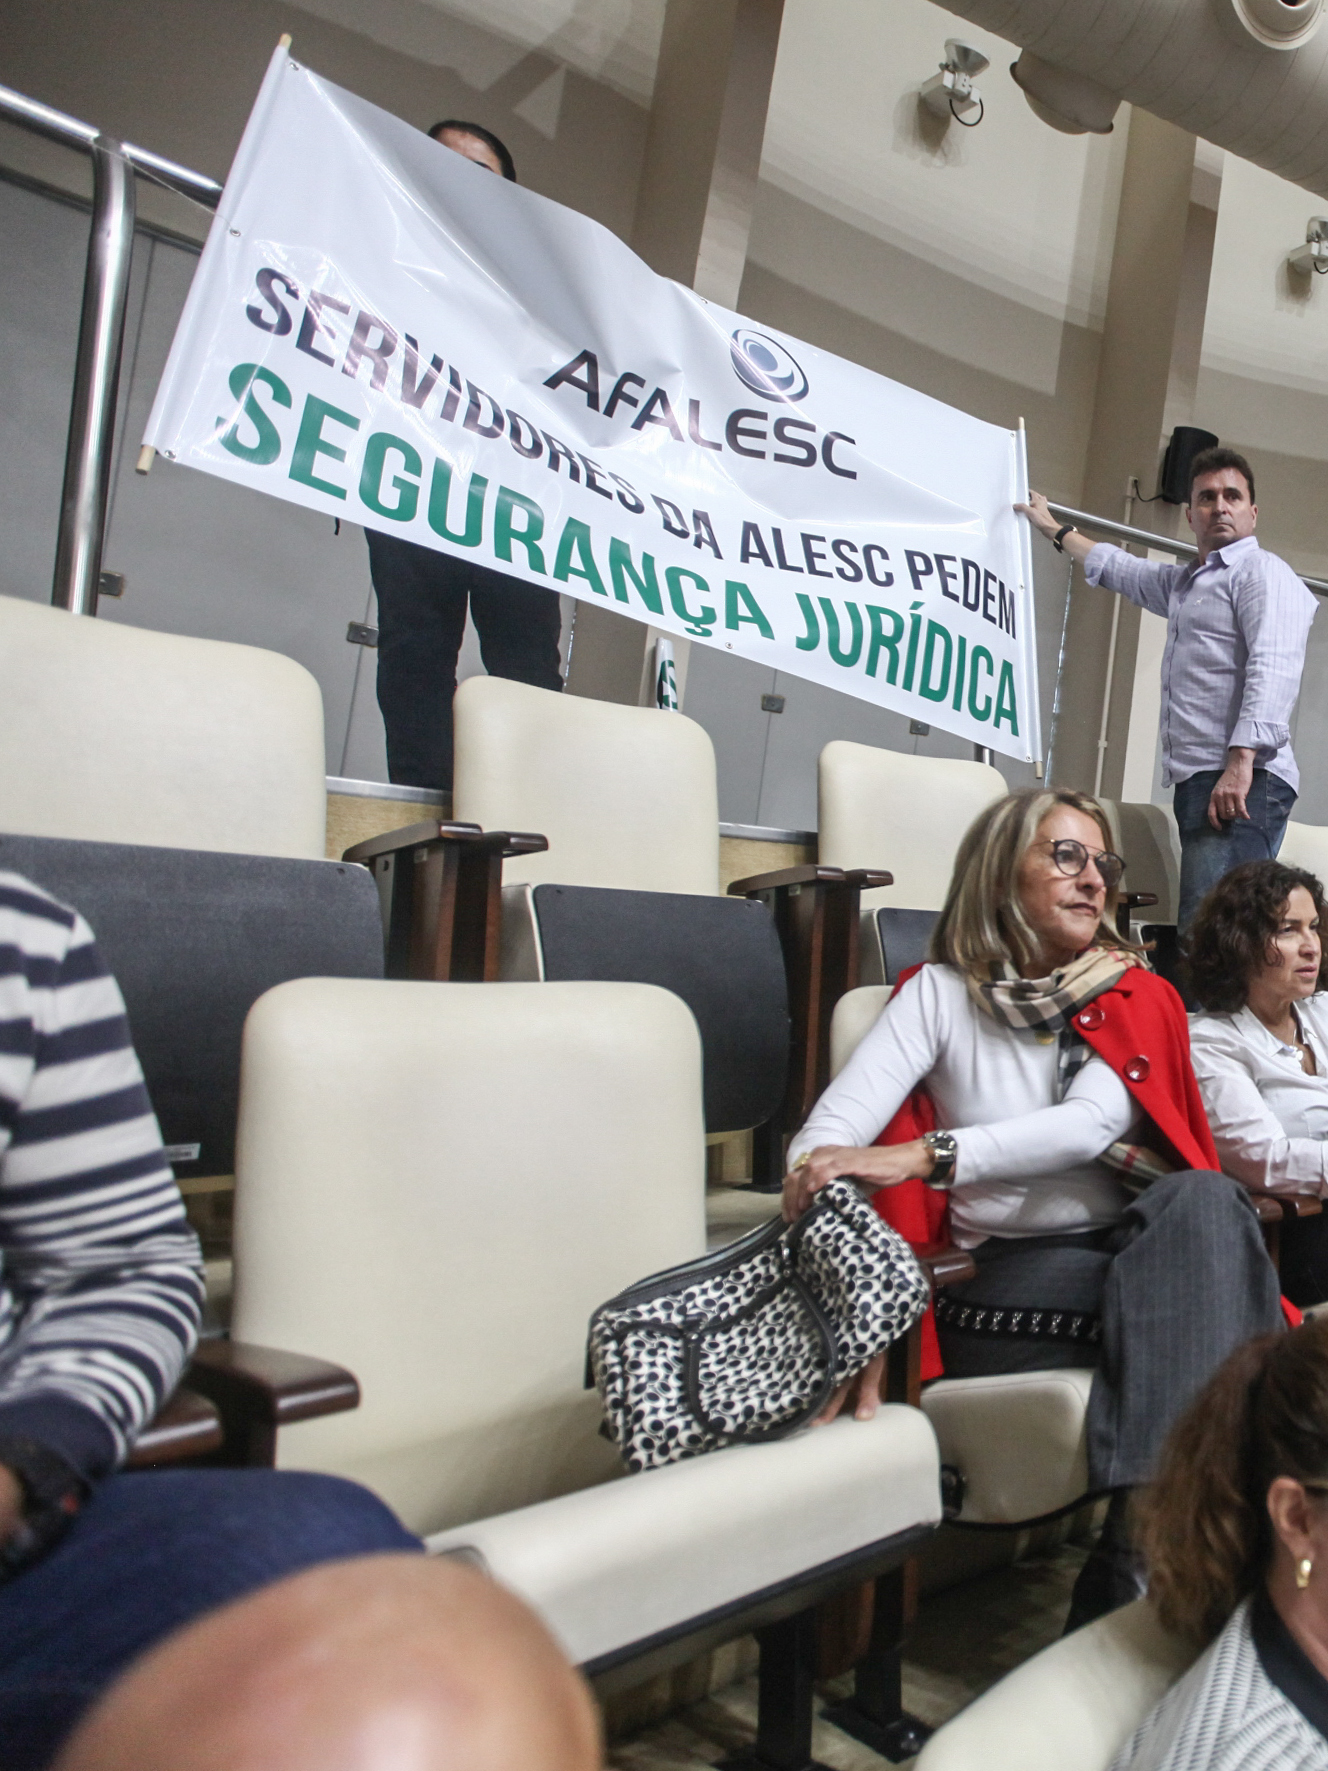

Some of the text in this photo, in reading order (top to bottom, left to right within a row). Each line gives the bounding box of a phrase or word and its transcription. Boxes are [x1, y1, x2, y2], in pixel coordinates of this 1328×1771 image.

[215, 363, 1019, 737] SEGURANÇA JURÍDICA
[246, 268, 1016, 640] SERVIDORES DA ALESC PEDEM
[542, 349, 857, 480] AFALESC
